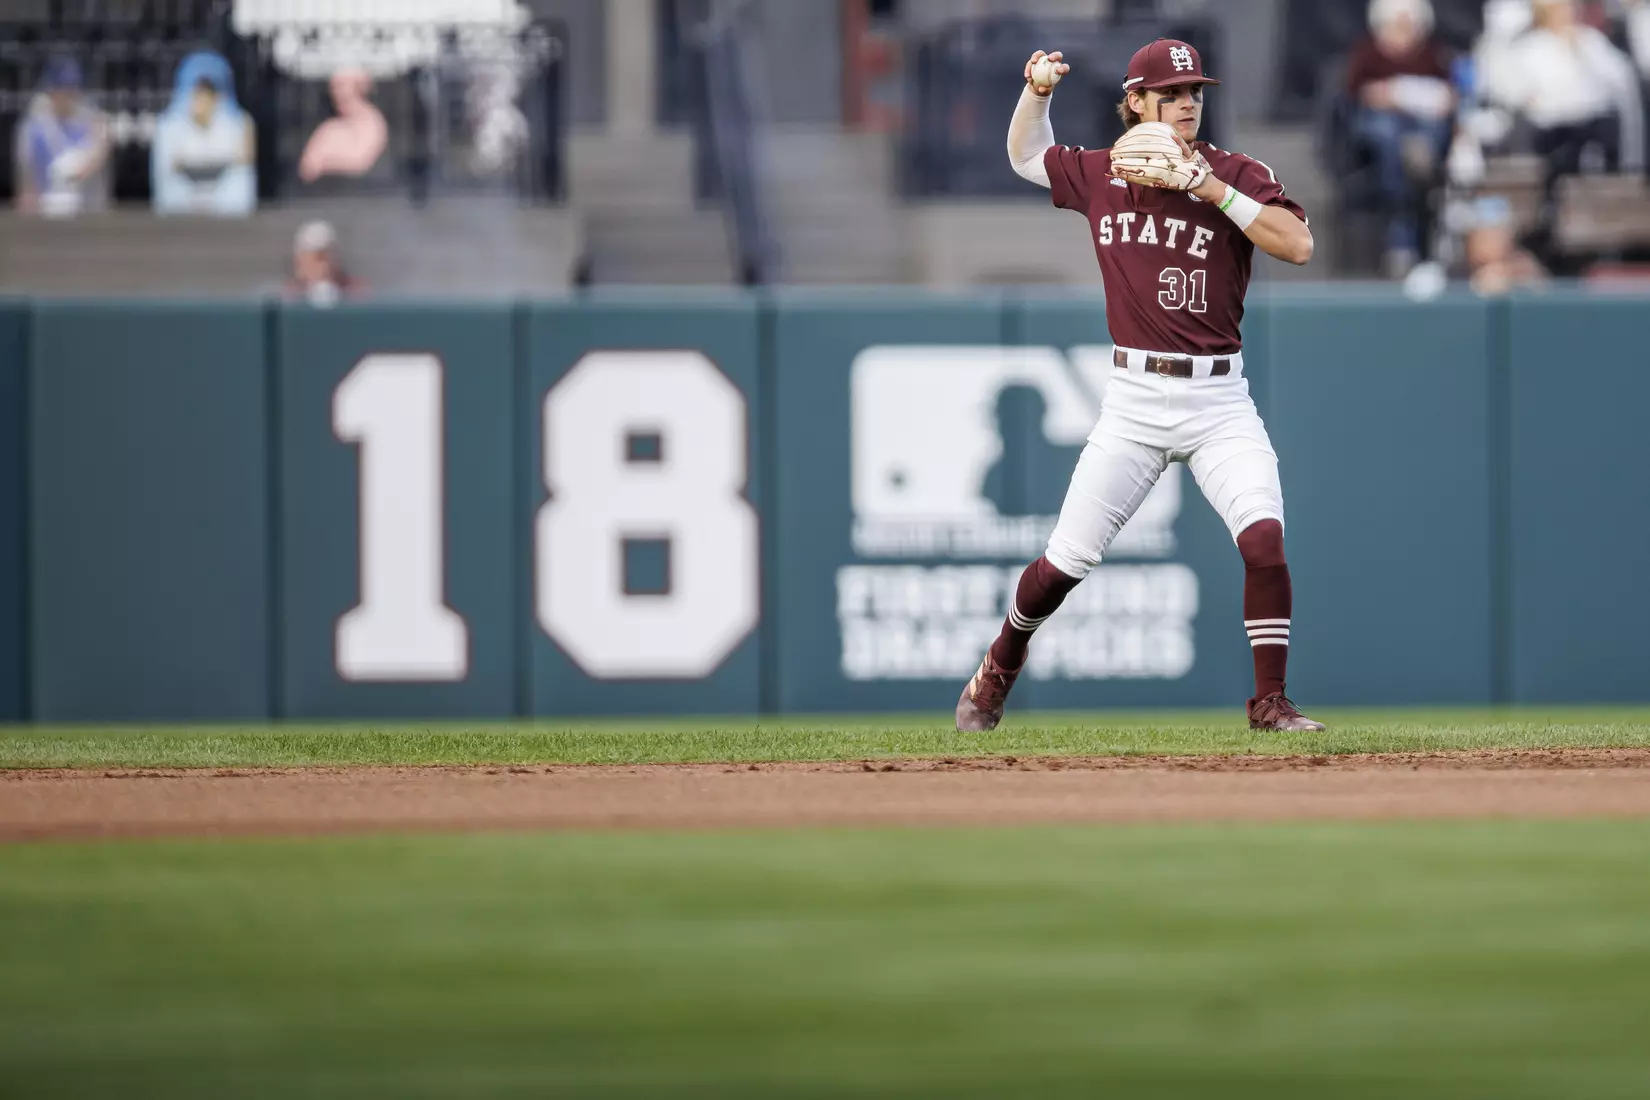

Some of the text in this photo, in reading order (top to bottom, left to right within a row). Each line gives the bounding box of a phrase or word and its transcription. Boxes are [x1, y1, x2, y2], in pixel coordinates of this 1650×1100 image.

[1099, 212, 1214, 259] STATE
[1158, 267, 1207, 313] 31
[331, 350, 760, 682] 18
